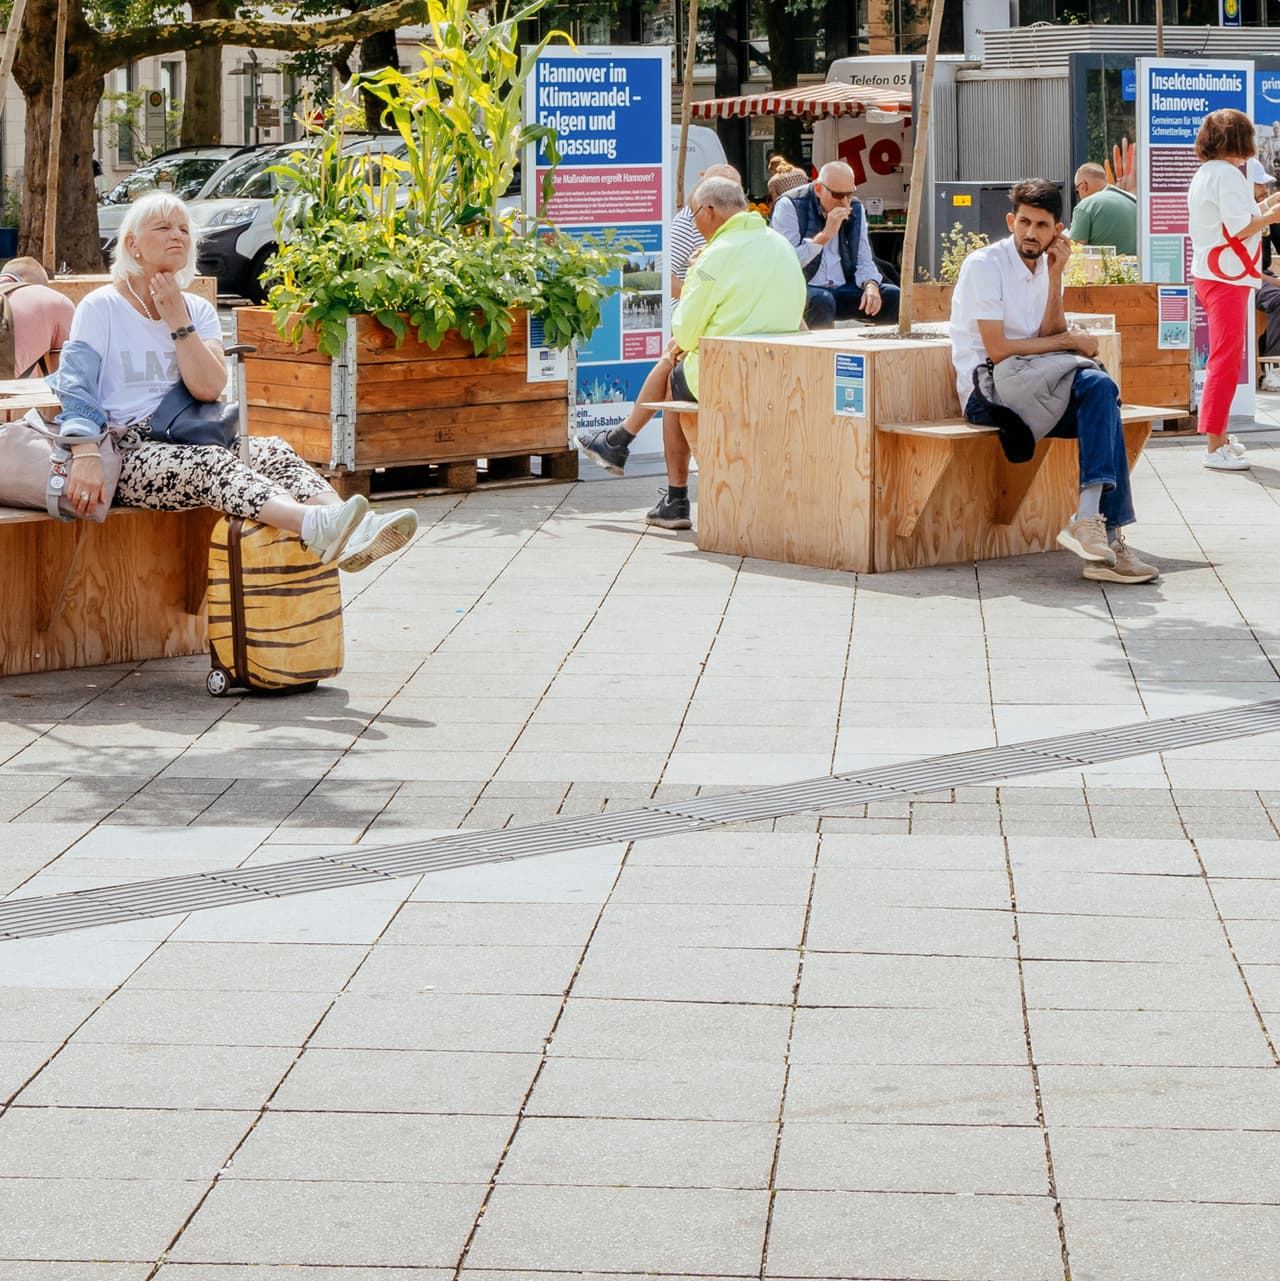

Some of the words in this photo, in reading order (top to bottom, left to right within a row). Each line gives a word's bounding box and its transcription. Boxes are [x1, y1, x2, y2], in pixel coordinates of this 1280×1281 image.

[539, 62, 607, 83] Hannover
[609, 62, 627, 83] im
[849, 74, 890, 86] Telefon
[1152, 71, 1242, 91] Insektenbündnis
[539, 86, 631, 107] Klimawandel
[1152, 93, 1209, 111] Hannover:
[539, 110, 587, 136] Folgen
[588, 110, 616, 131] und
[539, 136, 617, 159] Apassung
[563, 173, 600, 184] Maßnahmen
[601, 173, 623, 185] ergreift
[120, 350, 177, 383] LAZ
